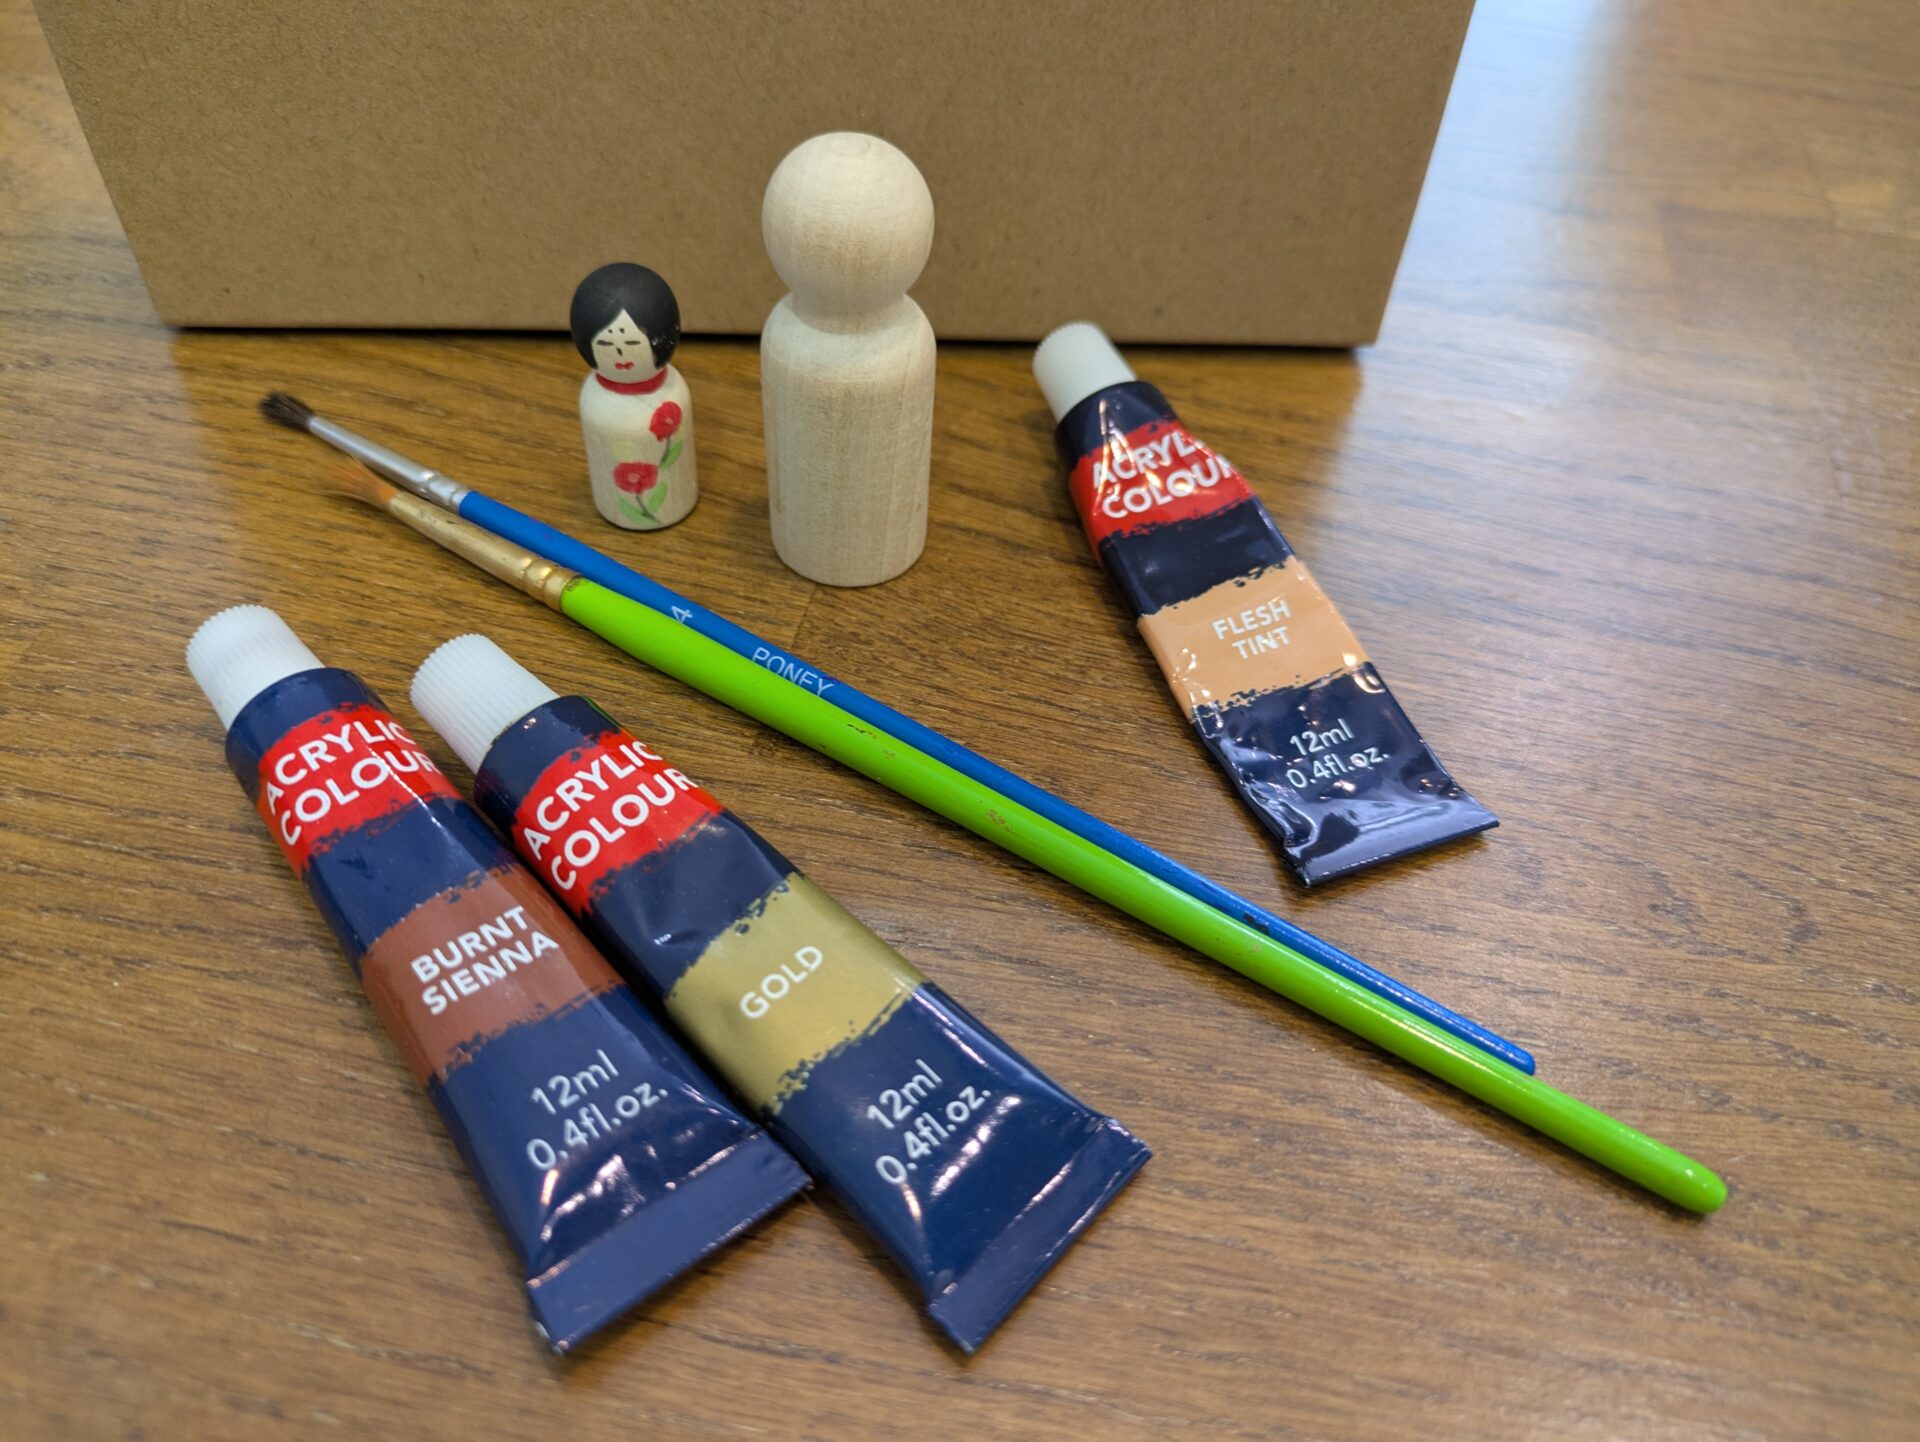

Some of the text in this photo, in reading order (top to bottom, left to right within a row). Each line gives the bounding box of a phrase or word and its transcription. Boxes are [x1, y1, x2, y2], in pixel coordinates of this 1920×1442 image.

[1093, 431, 1204, 488] ACRYL
[671, 605, 693, 624] 4
[1212, 599, 1291, 640] FLESH
[1232, 626, 1289, 659] TINT
[266, 719, 416, 815] ACRYLIC
[1289, 718, 1354, 755] 12ml
[281, 749, 442, 846] COLOUR
[523, 741, 663, 860] ACRYLIC
[551, 768, 699, 890] COLOUR
[410, 905, 528, 984] BURNT
[422, 930, 560, 1015] SIENNA
[739, 945, 823, 1019] GOLD
[531, 1048, 619, 1115] 12ml
[866, 1058, 943, 1129] 12ml
